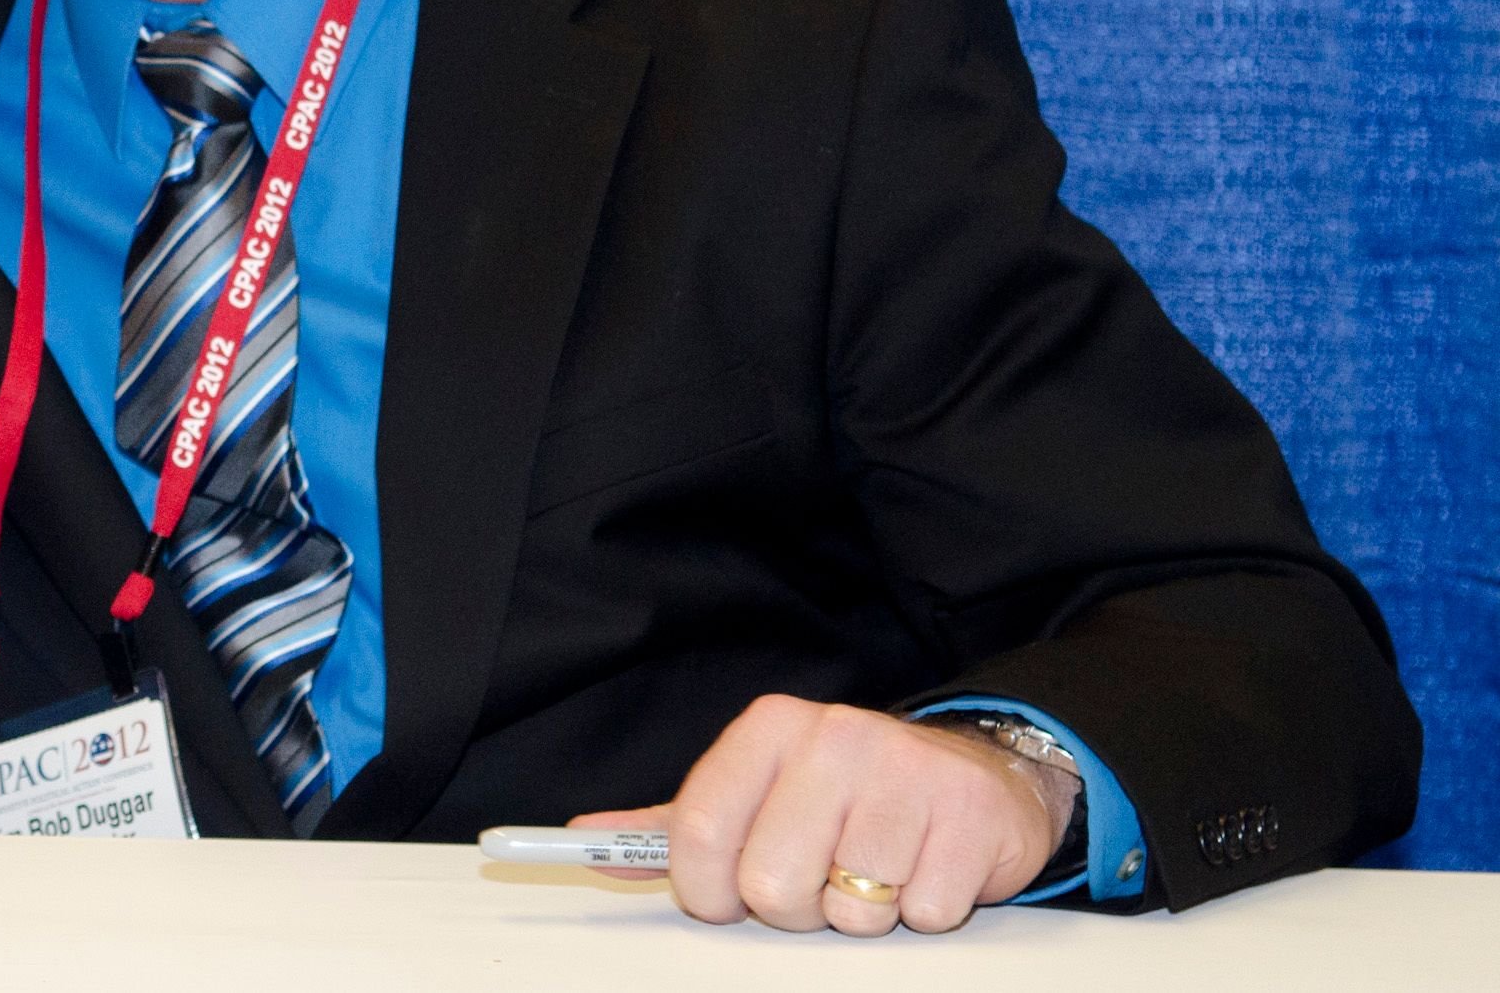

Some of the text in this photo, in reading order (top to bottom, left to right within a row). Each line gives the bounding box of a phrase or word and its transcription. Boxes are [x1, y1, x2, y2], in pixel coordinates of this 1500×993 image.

[285, 20, 347, 150] CPAC 2012
[228, 177, 293, 310] CPAC 2012
[171, 336, 235, 469] CPAC 2012
[72, 720, 150, 774] 2012
[28, 811, 71, 836] Bob
[77, 791, 154, 830] Duggar
